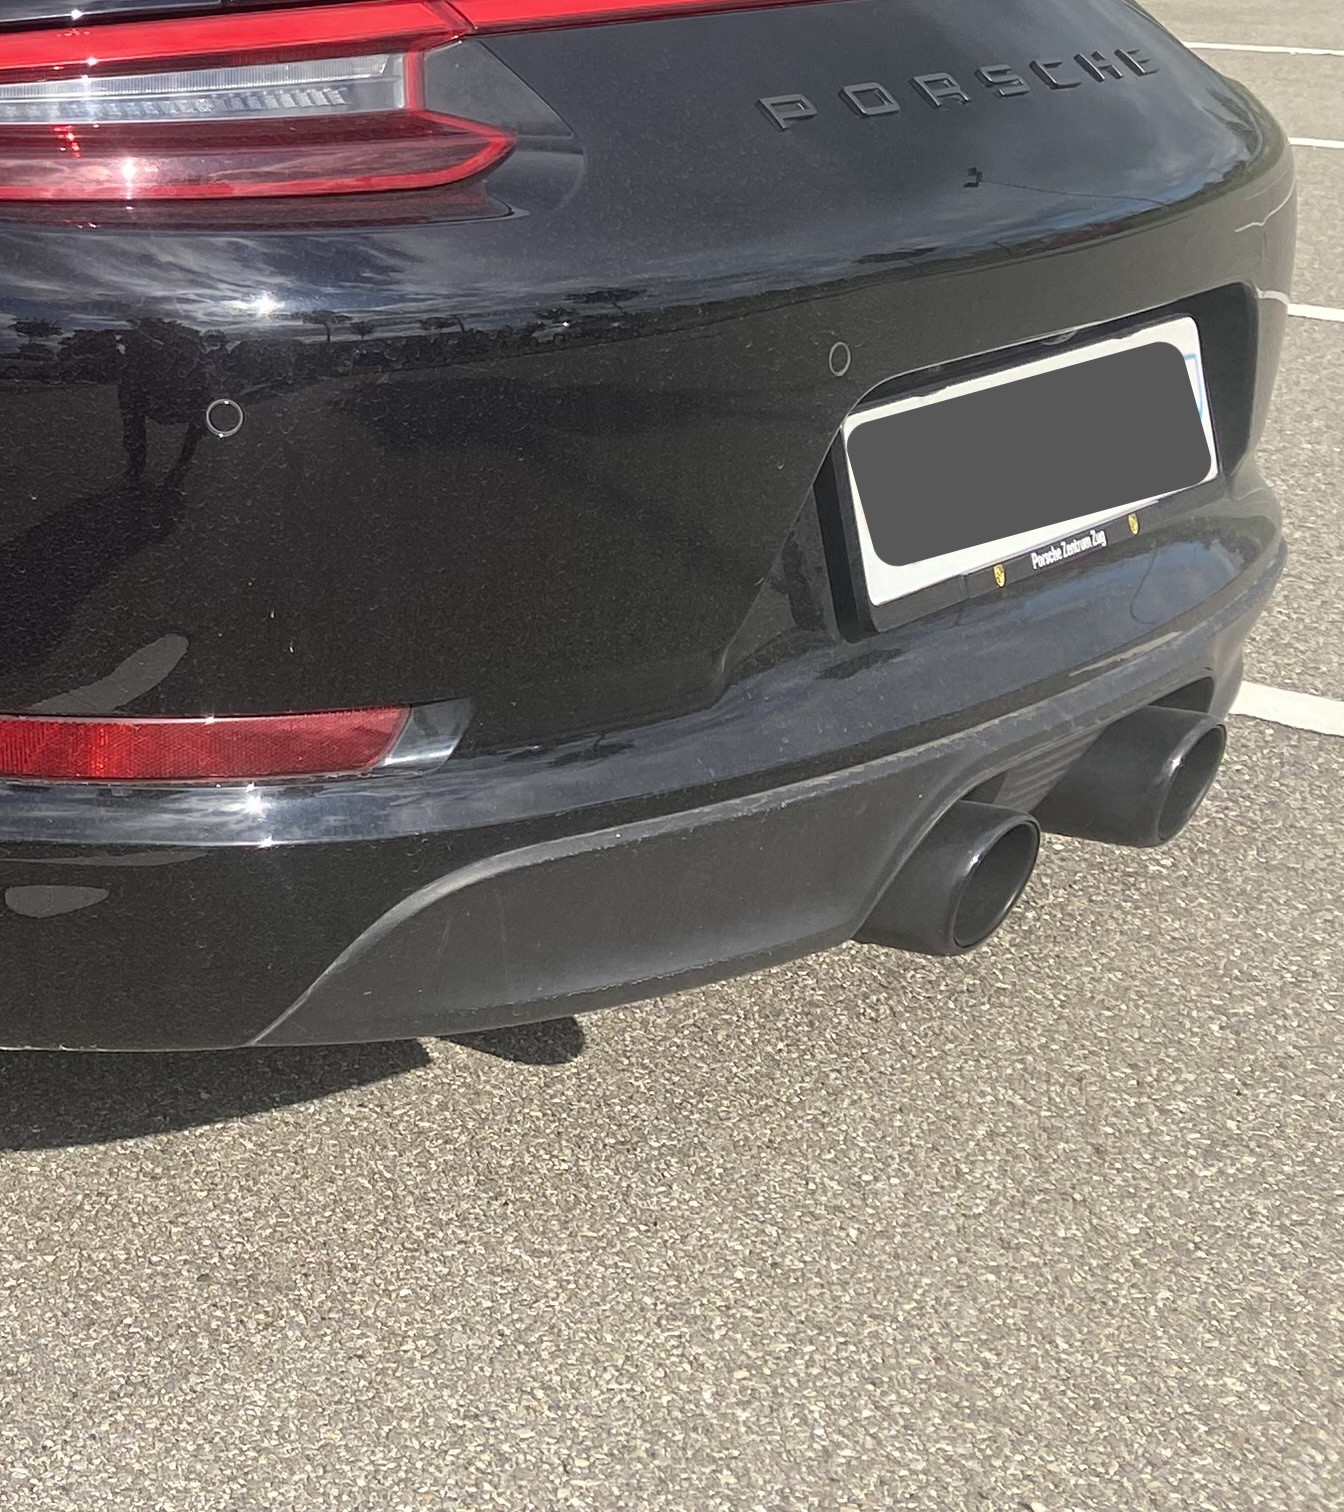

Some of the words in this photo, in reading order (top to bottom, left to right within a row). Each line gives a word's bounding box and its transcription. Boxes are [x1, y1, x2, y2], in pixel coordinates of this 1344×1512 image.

[754, 48, 1160, 131] PORSCHE
[1031, 545, 1062, 569] Porsche
[1060, 536, 1092, 558] Zentrum
[1090, 530, 1107, 547] Zug
